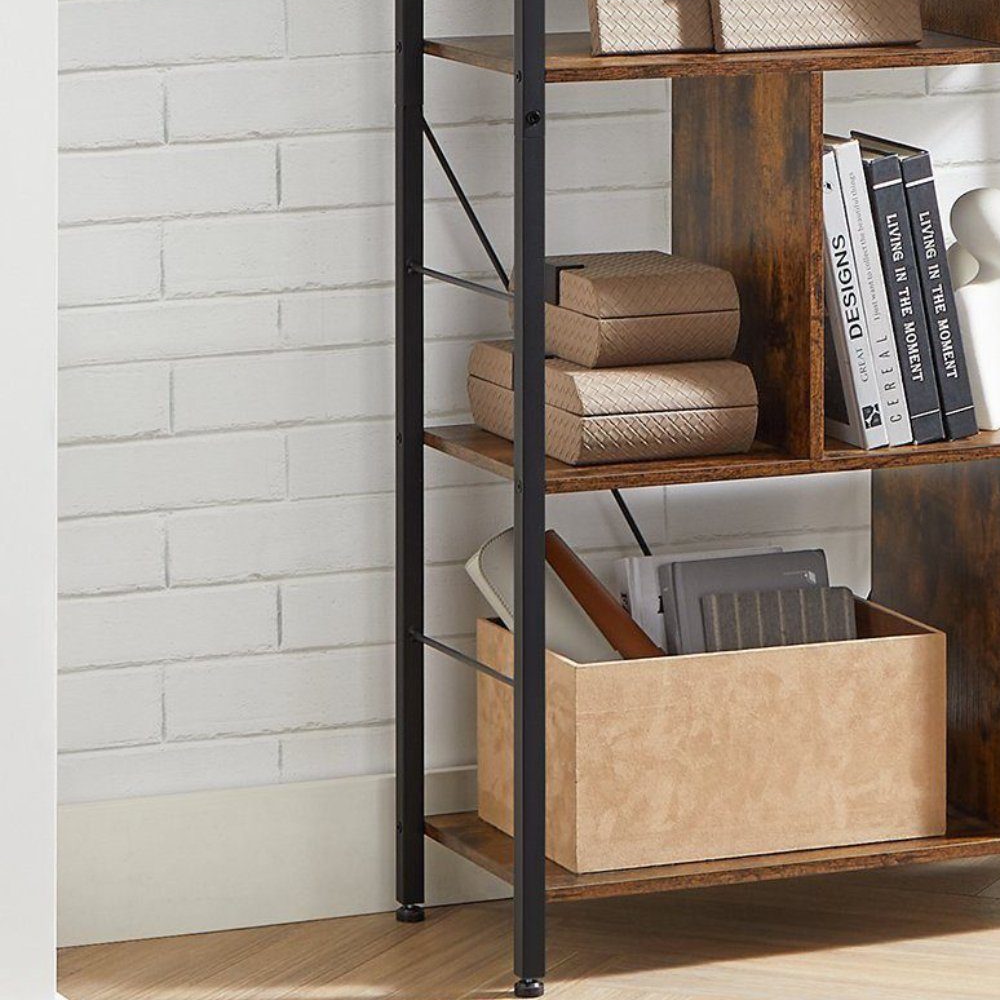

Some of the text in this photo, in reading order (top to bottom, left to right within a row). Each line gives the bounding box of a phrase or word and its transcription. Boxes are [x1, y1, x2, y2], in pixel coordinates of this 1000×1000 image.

[831, 234, 869, 383] GREAT DESIGNS
[886, 213, 924, 382] LIVING IN THE MOMENT
[919, 211, 959, 378] LIVING IN THE MOMENT
[876, 335, 903, 424] CEREAL
